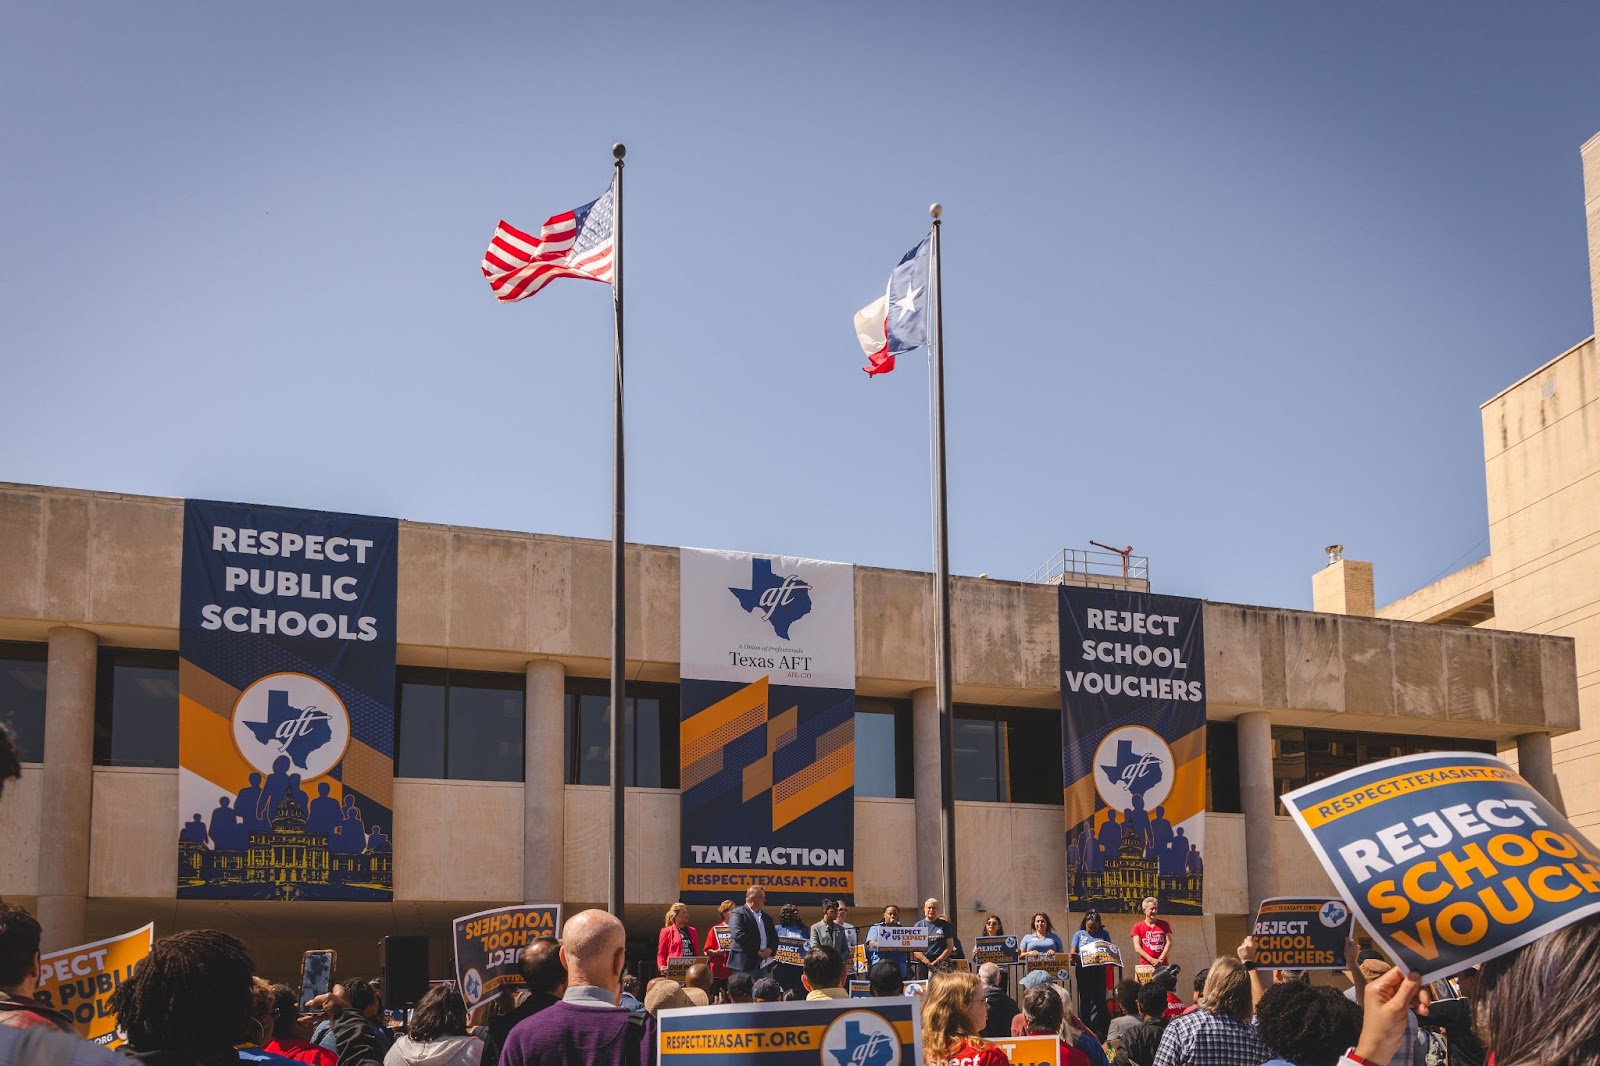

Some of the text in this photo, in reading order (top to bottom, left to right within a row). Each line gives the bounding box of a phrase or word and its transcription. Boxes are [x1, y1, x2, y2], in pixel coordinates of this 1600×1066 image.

[212, 525, 374, 564] RESPECT
[225, 566, 358, 601] PUBLIC
[759, 574, 813, 622] aft
[200, 603, 378, 641] SCHOOLS
[1087, 607, 1180, 637] REJECT
[729, 651, 812, 671] Texas AFT
[1082, 639, 1187, 669] SCHOOL
[1065, 670, 1203, 702] VOUCHERS
[275, 705, 333, 753] aft
[1121, 752, 1164, 791] aft
[691, 845, 845, 867] TAKE ACTION
[1338, 799, 1549, 884] REJECT
[687, 874, 848, 888] RESPECT.TEXASAFT.ORG
[465, 912, 554, 940] VOUCHERS
[1252, 920, 1308, 935] REJECT
[486, 948, 524, 970] JECT
[776, 950, 802, 959] CHOOL
[777, 944, 799, 953] EJECT
[38, 948, 108, 987] PECT
[666, 1030, 811, 1049] RESPECT.TEXASAFT.ORG
[851, 1030, 894, 1066] aft
